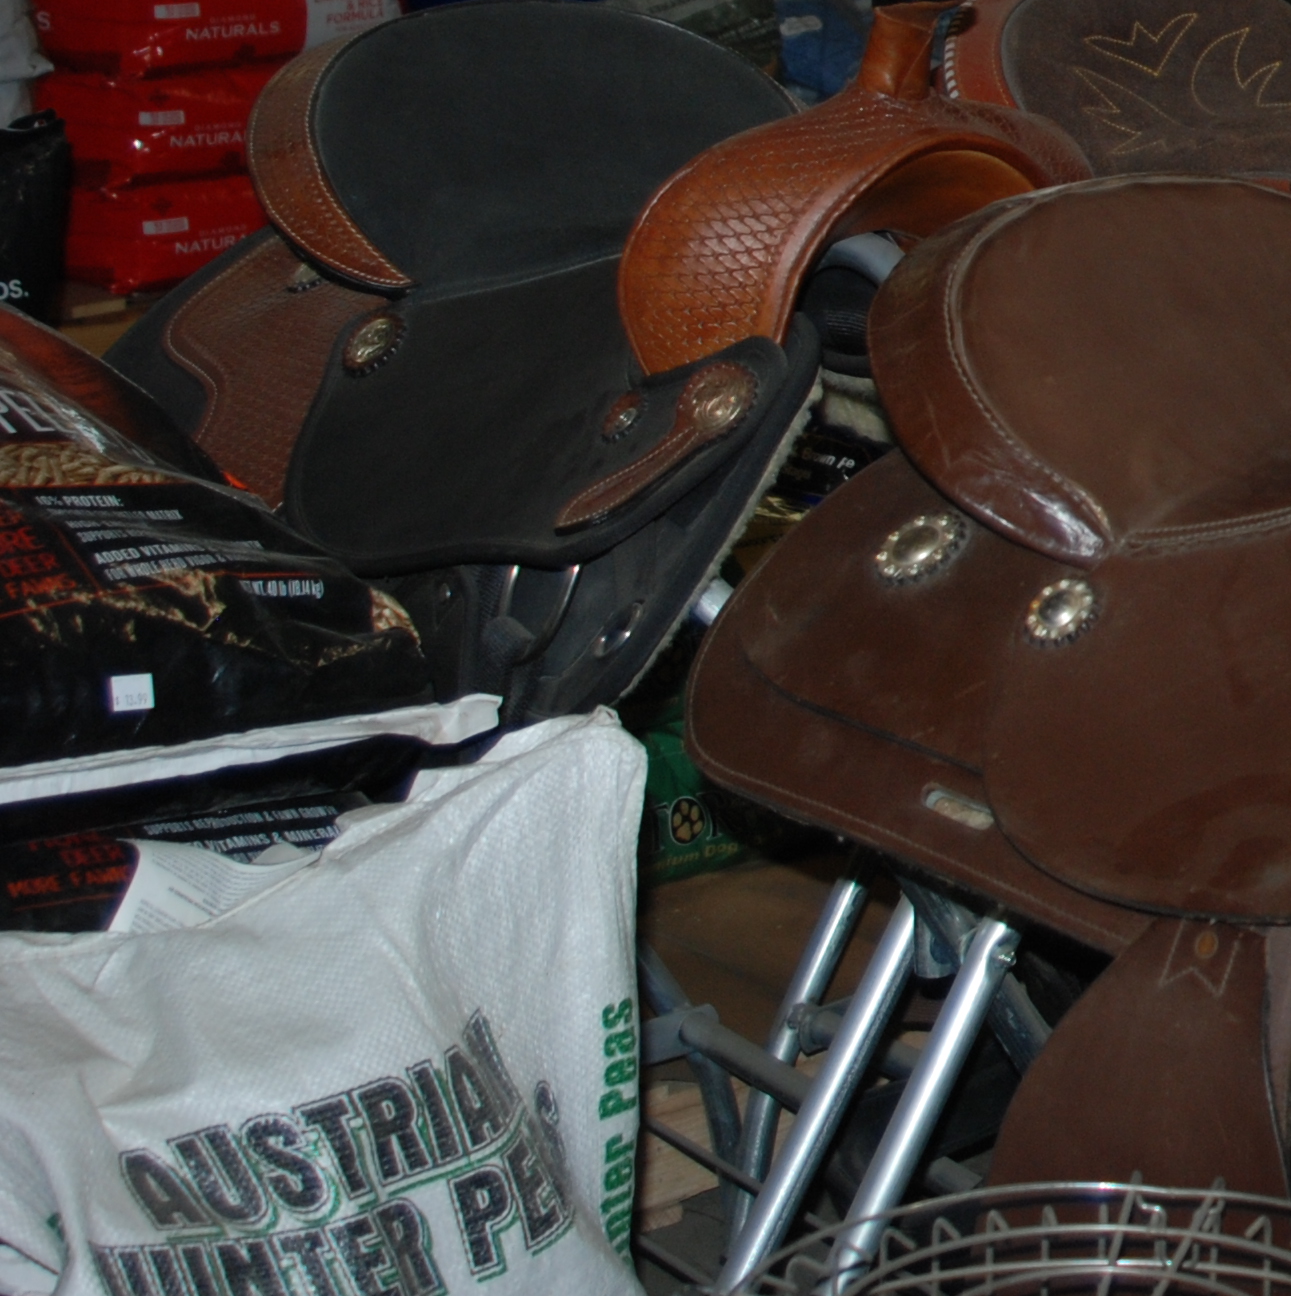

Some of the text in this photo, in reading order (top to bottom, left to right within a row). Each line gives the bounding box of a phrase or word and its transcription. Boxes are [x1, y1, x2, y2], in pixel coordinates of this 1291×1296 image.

[326, 7, 385, 25] FORMULA
[185, 20, 283, 42] NATURALS
[169, 130, 246, 149] NATURA
[62, 495, 124, 507] PROTEIN:
[94, 547, 141, 565] ADDED
[125, 561, 162, 577] WHOLE
[311, 578, 326, 600] kg)
[143, 821, 195, 836] SUPPORTS
[204, 831, 272, 853] VITAMINS
[283, 824, 342, 844] MINERAL
[599, 997, 638, 1121] Peas
